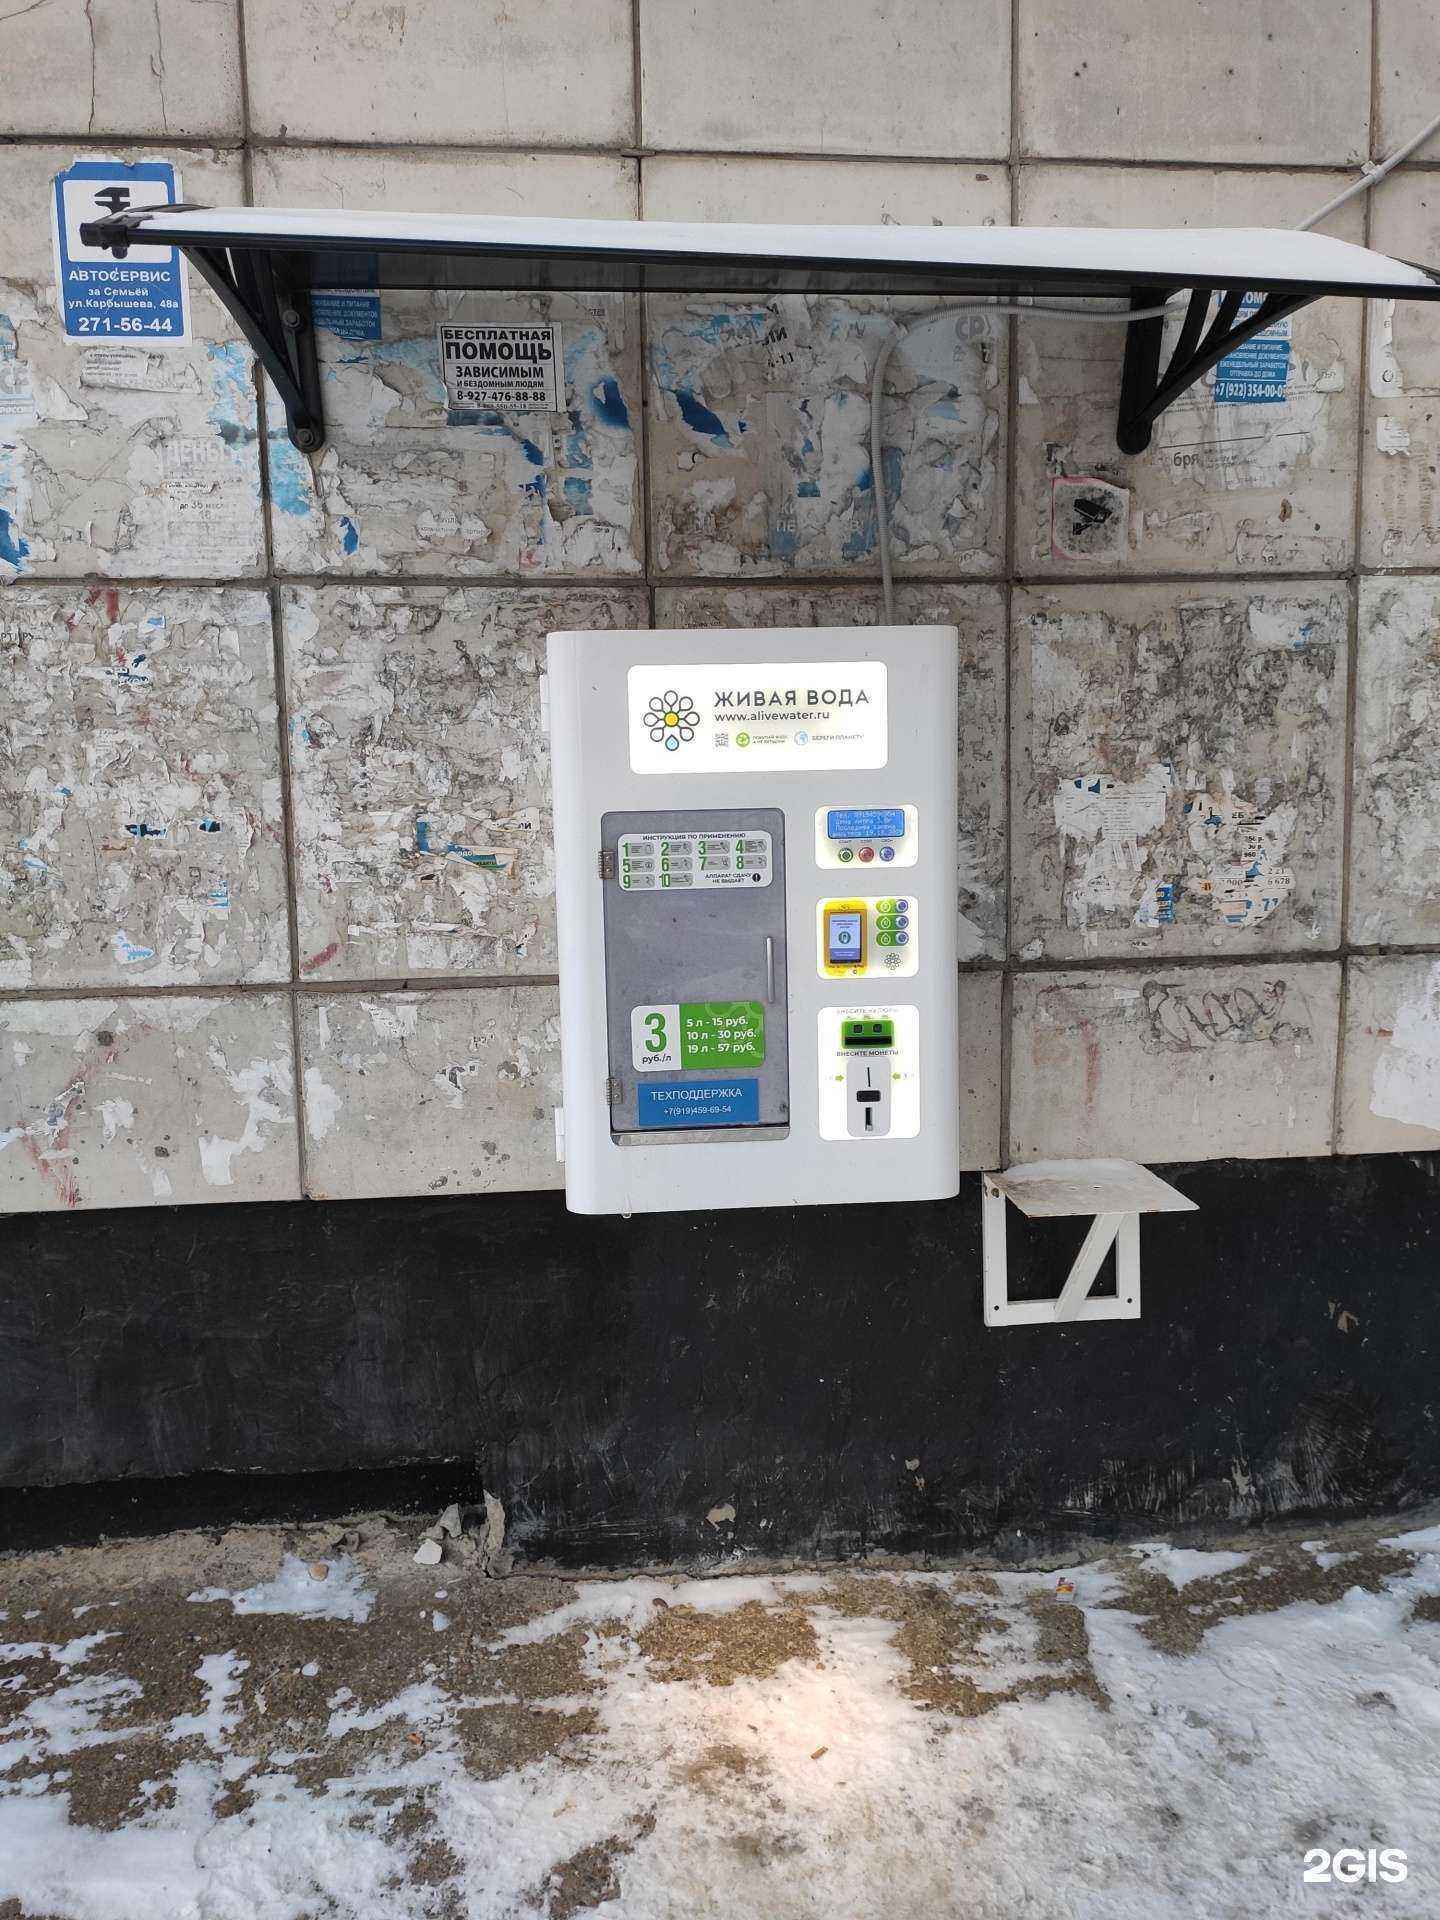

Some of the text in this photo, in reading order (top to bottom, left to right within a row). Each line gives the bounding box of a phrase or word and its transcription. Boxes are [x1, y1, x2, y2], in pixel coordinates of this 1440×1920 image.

[69, 270, 171, 281] АВТОСЕРВИС
[88, 288, 101, 296] за
[69, 299, 179, 310] ул.Карбышева, 48а
[79, 317, 173, 332] 271-56-44
[444, 329, 551, 340] БЕСПЛАТНАЯ
[445, 342, 552, 364] ПОМОЩЬ
[455, 366, 544, 378] ЗАВИСИМЫМ
[463, 380, 513, 389] БЕЗДОМНЫМ
[457, 391, 546, 401] 8-927-476-88-88
[714, 689, 869, 708] ЖИВАЯ ВОДА
[714, 711, 830, 722] www.alivewater.ru
[622, 842, 631, 857] 1
[661, 842, 669, 856] 2
[698, 841, 706, 855] 3
[736, 840, 744, 854] 4
[622, 859, 631, 873] 5
[661, 858, 669, 872] 6
[700, 856, 707, 870] 7
[736, 855, 744, 869] 8
[623, 874, 631, 888] 9
[659, 873, 670, 887] 10
[686, 1018, 693, 1027] 5
[712, 1017, 723, 1026] 15
[725, 1015, 748, 1027] руб.
[644, 1013, 667, 1052] 3
[687, 1031, 699, 1040] 10
[718, 1030, 731, 1038] 30
[733, 1028, 756, 1040] руб.
[688, 1044, 699, 1053] 19
[718, 1043, 729, 1052] 57
[732, 1042, 756, 1053] руб.
[642, 1054, 671, 1064] руб./л
[651, 1089, 742, 1101] ТЕХПОДДЕРЖКА
[664, 1105, 732, 1116] +7(919)459-69-54
